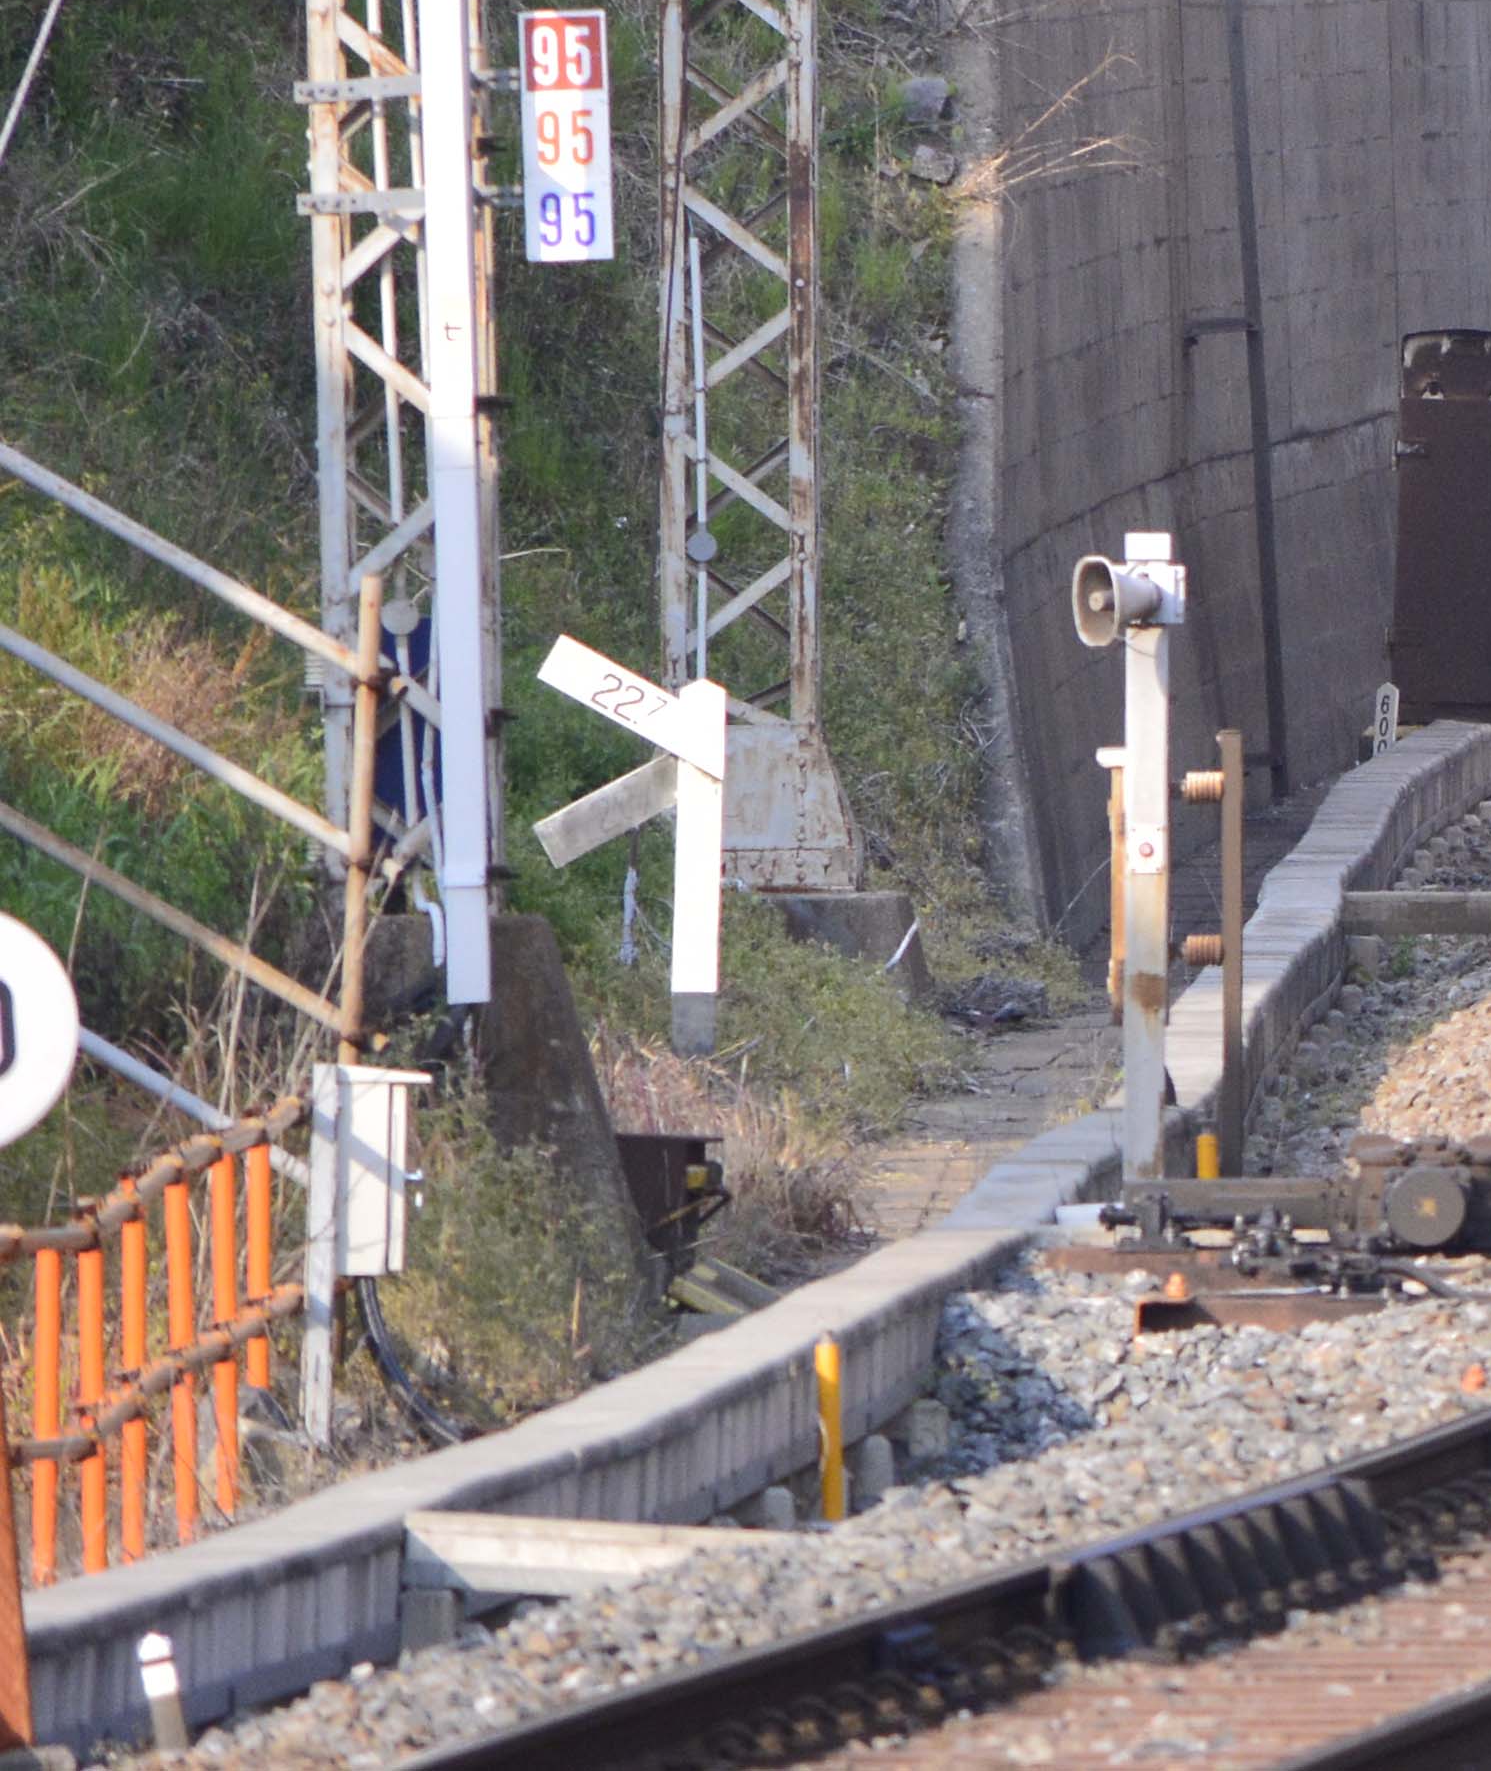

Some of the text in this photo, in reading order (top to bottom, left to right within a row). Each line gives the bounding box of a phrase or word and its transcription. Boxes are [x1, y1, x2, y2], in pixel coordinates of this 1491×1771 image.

[532, 25, 592, 86] 95
[536, 109, 594, 166] 95
[540, 191, 596, 247] 95
